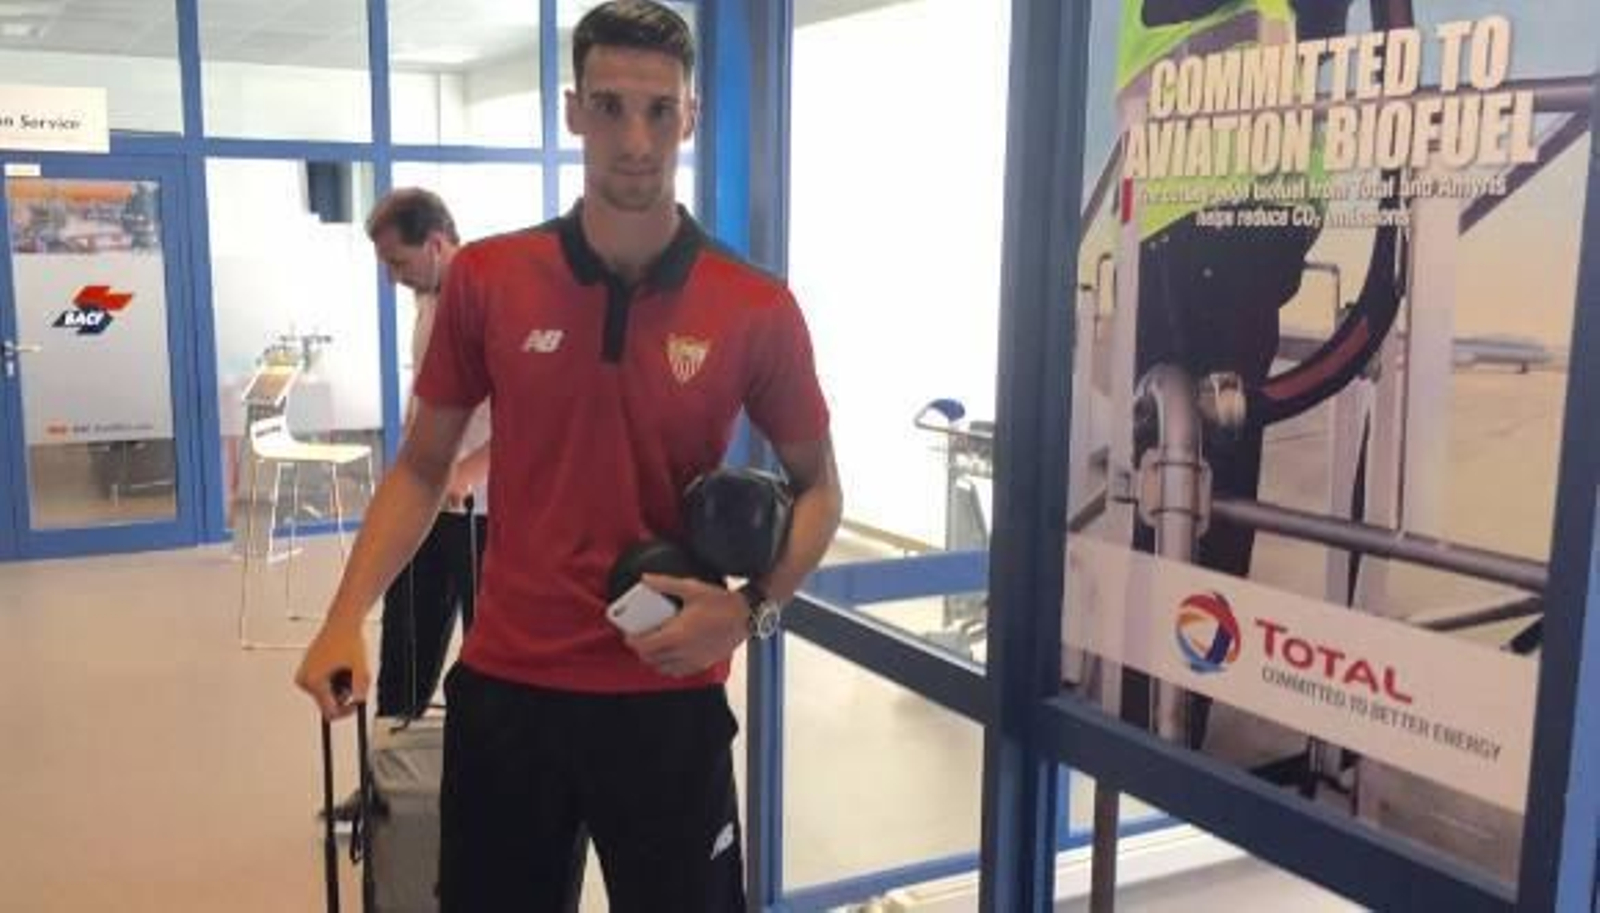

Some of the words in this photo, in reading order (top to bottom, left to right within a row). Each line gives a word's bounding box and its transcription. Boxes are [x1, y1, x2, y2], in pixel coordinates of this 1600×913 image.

[1148, 28, 1423, 119] COMMITTED
[1436, 15, 1512, 91] TO
[20, 114, 82, 129] Service
[1123, 107, 1313, 180] AVIATION
[1322, 89, 1538, 171] BIOFUEL
[1253, 180, 1306, 200] biofuel
[1310, 180, 1346, 198] from
[1352, 175, 1394, 197] Total
[1399, 172, 1432, 196] and
[1237, 208, 1288, 226] reduce
[1261, 666, 1346, 707] COMMITTED
[1350, 694, 1369, 716] TO
[1370, 705, 1429, 740] BETTER
[1432, 723, 1501, 763] ENERGY
